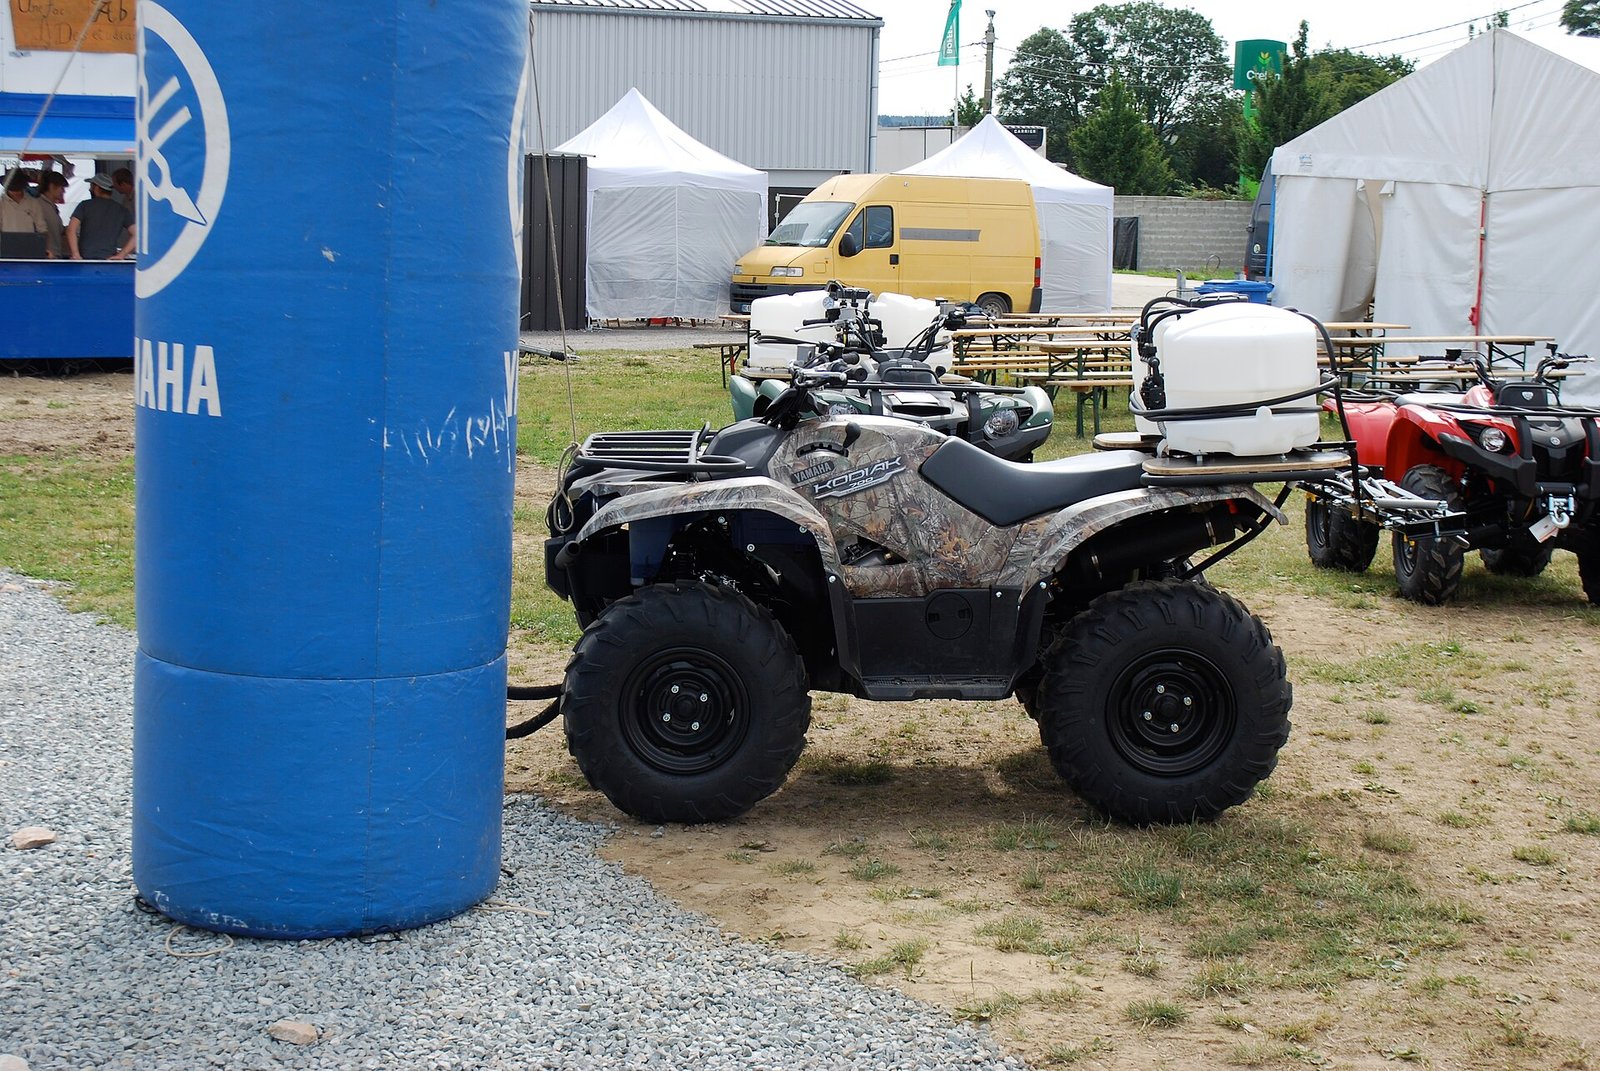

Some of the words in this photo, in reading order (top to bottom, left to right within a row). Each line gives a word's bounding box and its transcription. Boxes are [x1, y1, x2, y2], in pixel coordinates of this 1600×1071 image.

[1246, 70, 1281, 80] Creln
[134, 336, 222, 417] AHA
[793, 462, 832, 482] YAMAHA
[814, 456, 902, 494] KODIAK
[849, 477, 874, 488] 700
